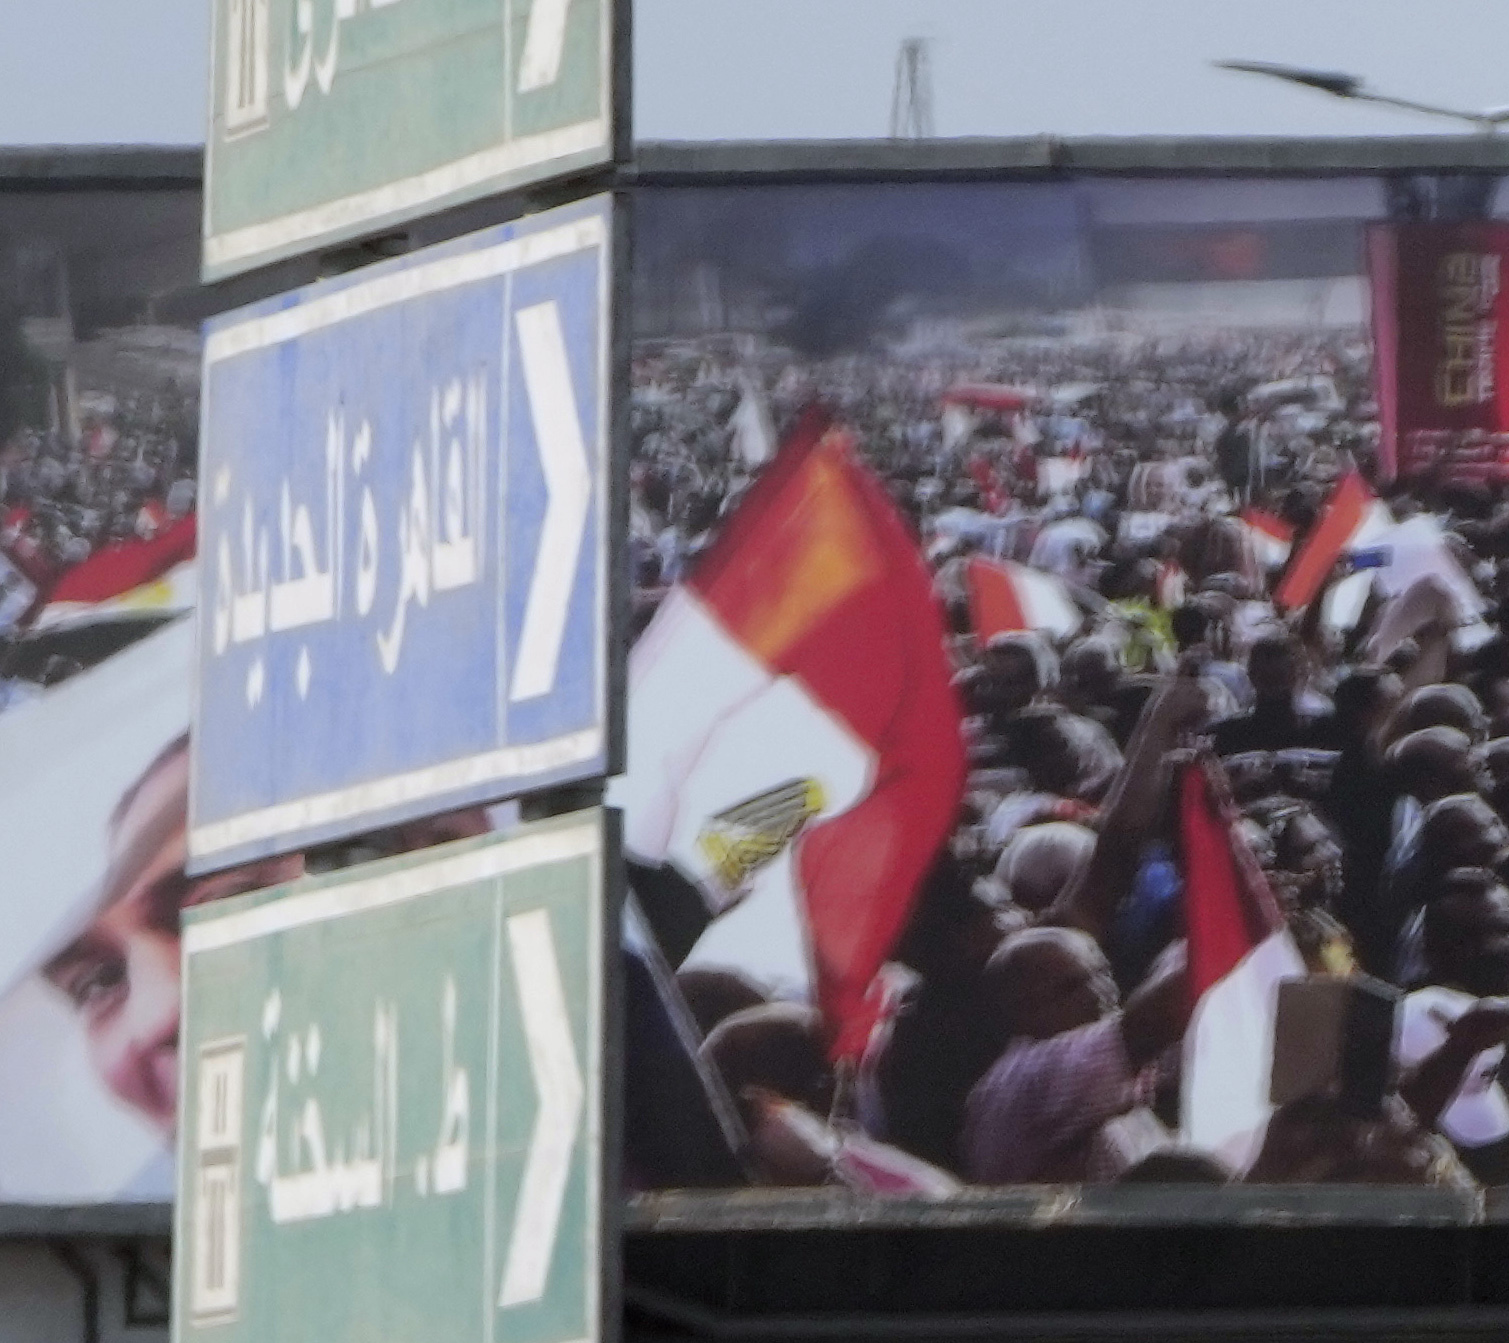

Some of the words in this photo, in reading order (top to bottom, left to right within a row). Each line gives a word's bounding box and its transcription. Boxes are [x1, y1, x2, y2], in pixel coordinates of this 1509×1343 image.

[213, 404, 346, 709] الجديدة
[350, 371, 487, 675] القاهرة
[254, 985, 398, 1224] السخنة
